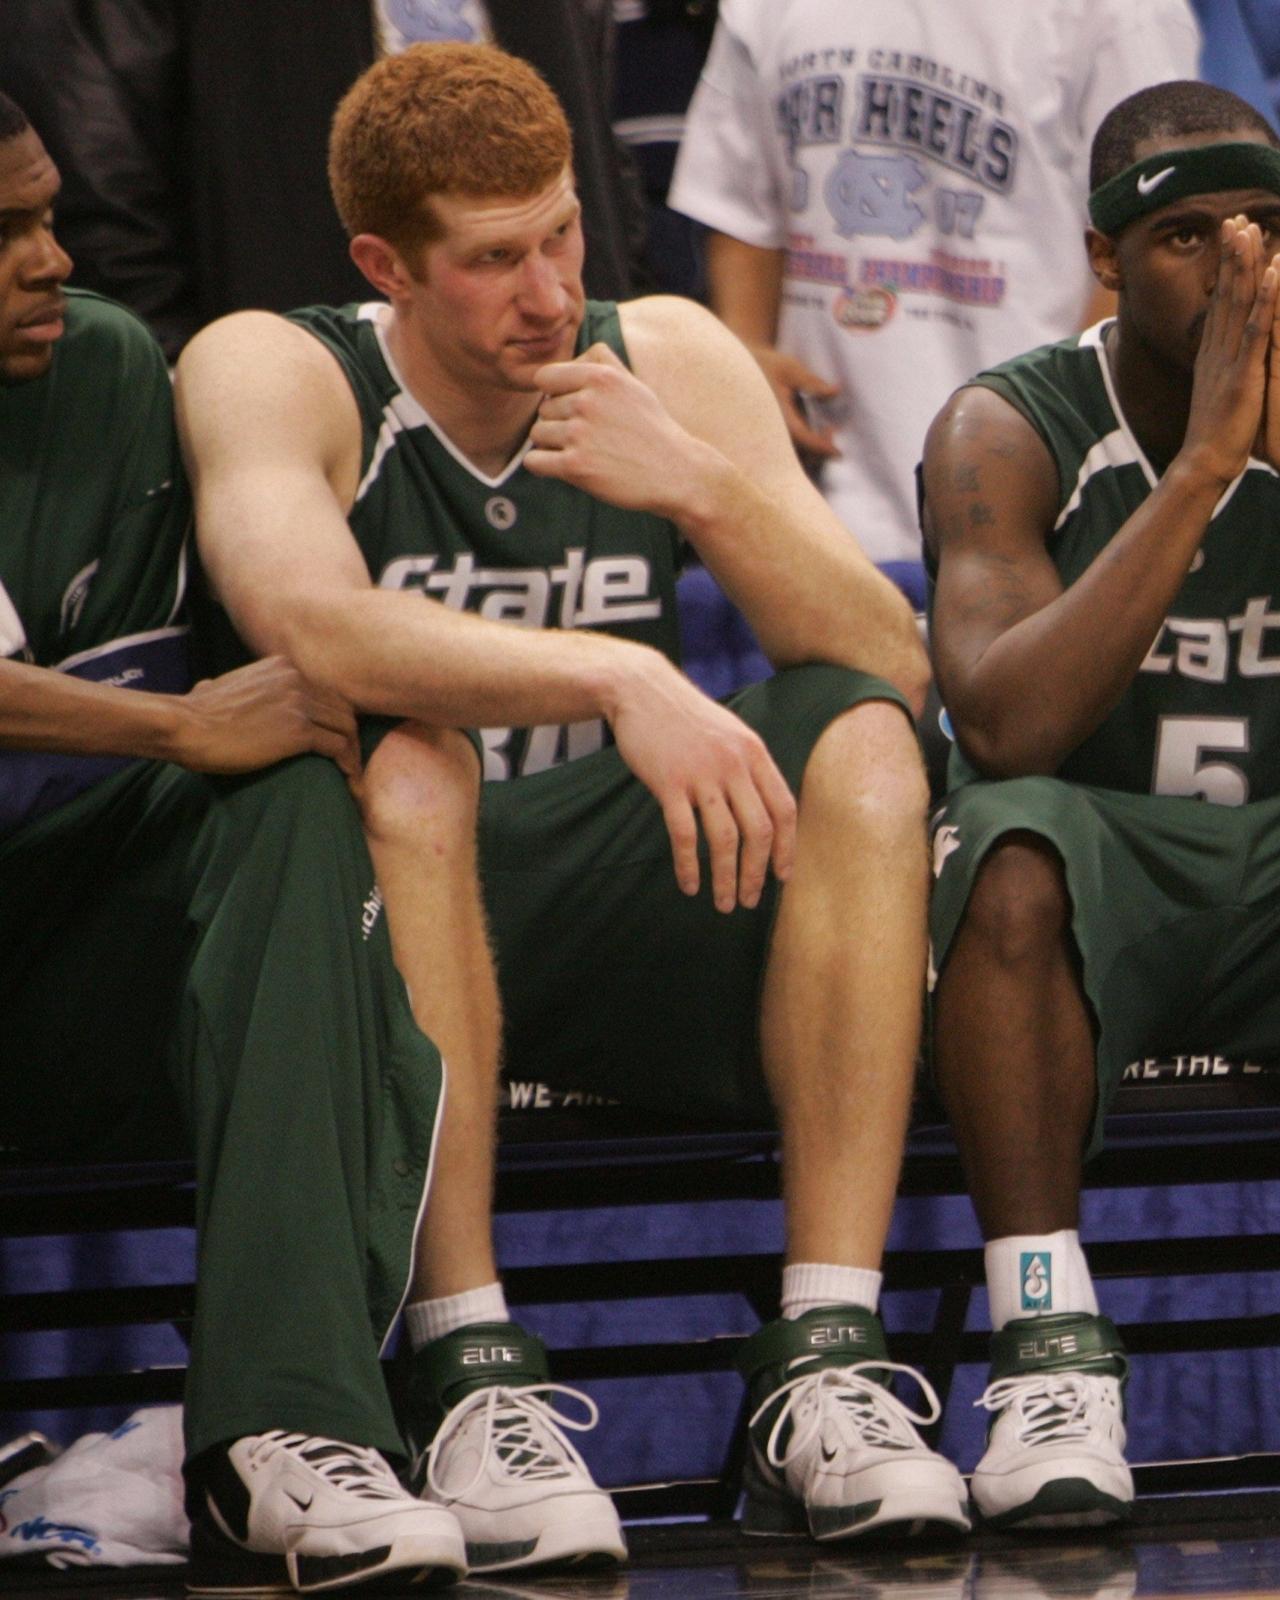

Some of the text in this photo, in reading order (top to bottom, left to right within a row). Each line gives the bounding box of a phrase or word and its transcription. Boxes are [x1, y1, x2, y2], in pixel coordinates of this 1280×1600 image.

[854, 73, 1019, 196] HEELS
[1153, 714, 1249, 807] 5
[509, 1082, 551, 1110] WE
[811, 1326, 868, 1345] ELITE
[1020, 1334, 1078, 1359] ELITE
[463, 1346, 522, 1365] ELITE
